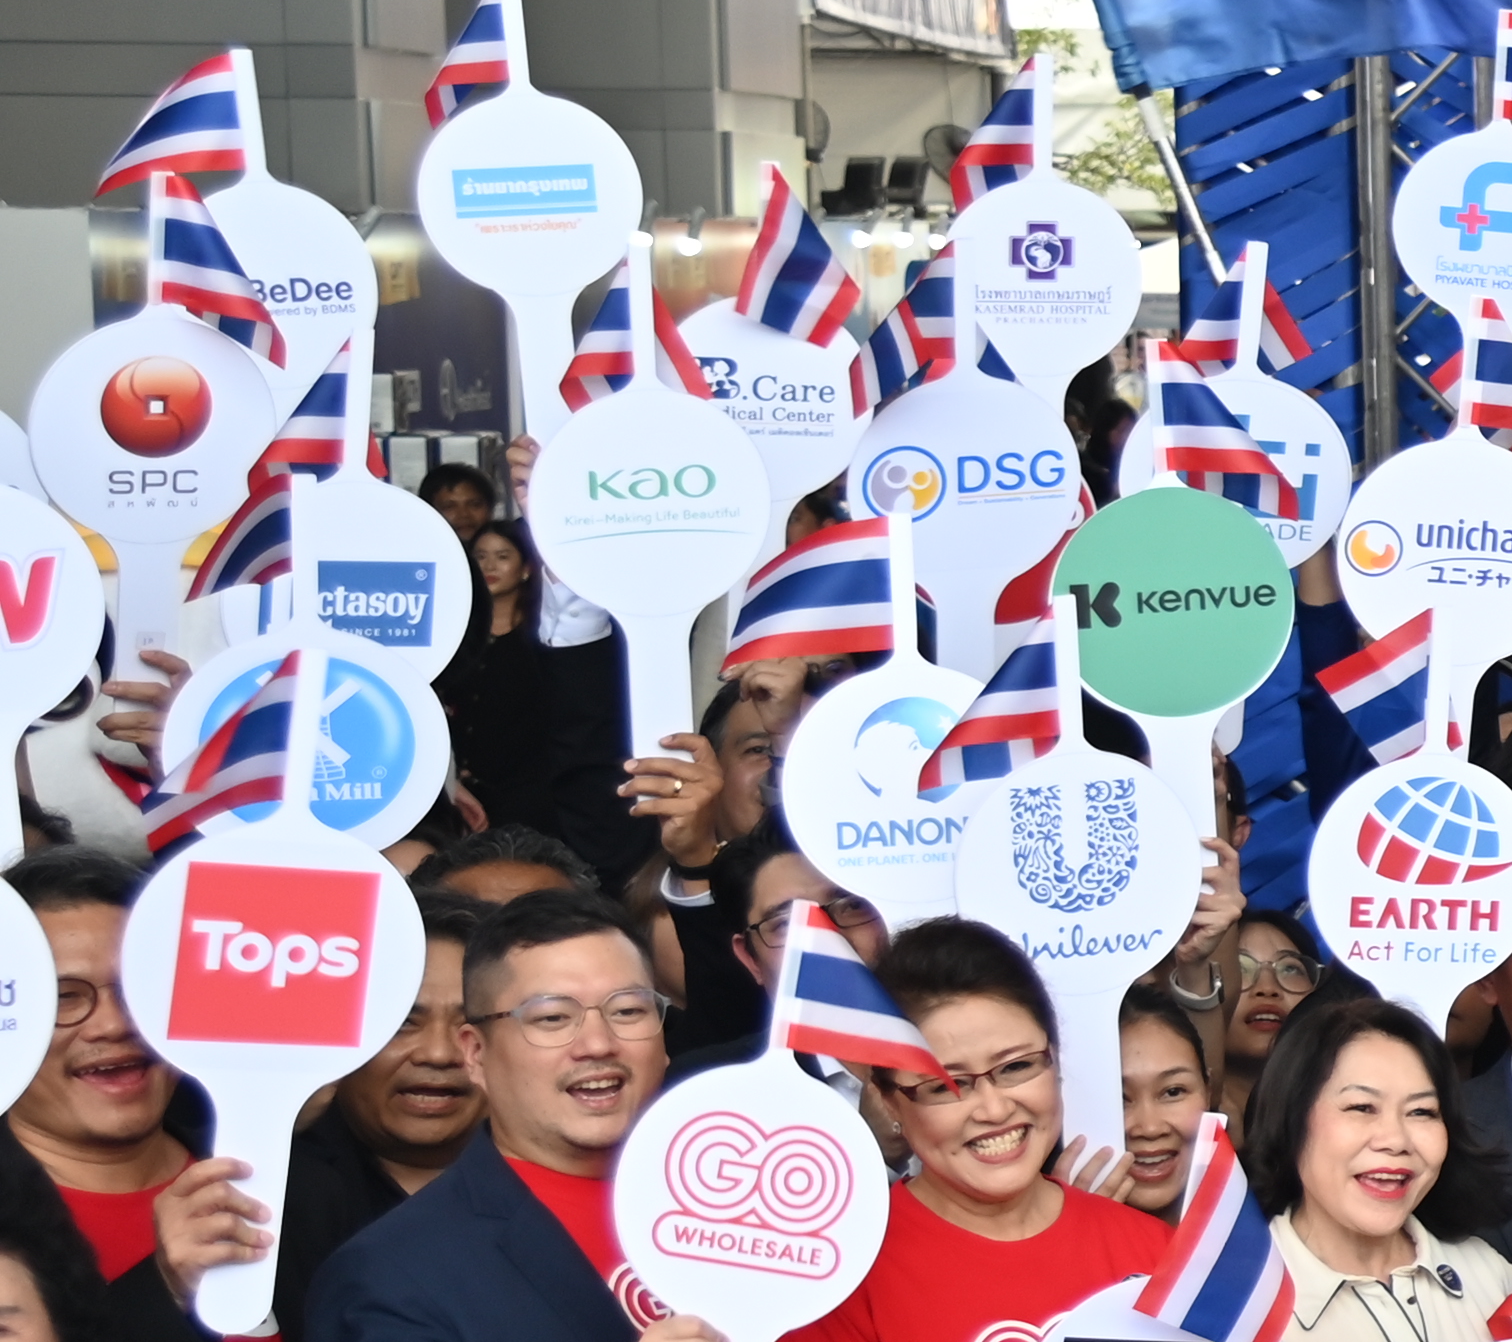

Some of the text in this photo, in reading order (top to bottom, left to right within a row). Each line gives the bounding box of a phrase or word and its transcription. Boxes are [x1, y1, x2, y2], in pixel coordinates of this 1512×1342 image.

[1434, 273, 1488, 288] PIYAVATE
[321, 302, 357, 316] BDMS
[975, 304, 1112, 316] KASEMRAD HOSPITAL
[771, 406, 836, 424] Center
[107, 469, 200, 495] SPC
[957, 449, 1066, 494] DSG
[655, 505, 742, 523] Life Beautiful
[319, 584, 430, 625] ctasoy
[387, 627, 418, 638] 1981
[324, 781, 384, 802] Mill
[835, 816, 970, 851] DANON
[1348, 895, 1500, 933] EARTH
[191, 918, 362, 988] Tops
[1347, 939, 1498, 965] Act For Life
[664, 1110, 855, 1237] GO
[672, 1222, 823, 1268] WHOLESALE
